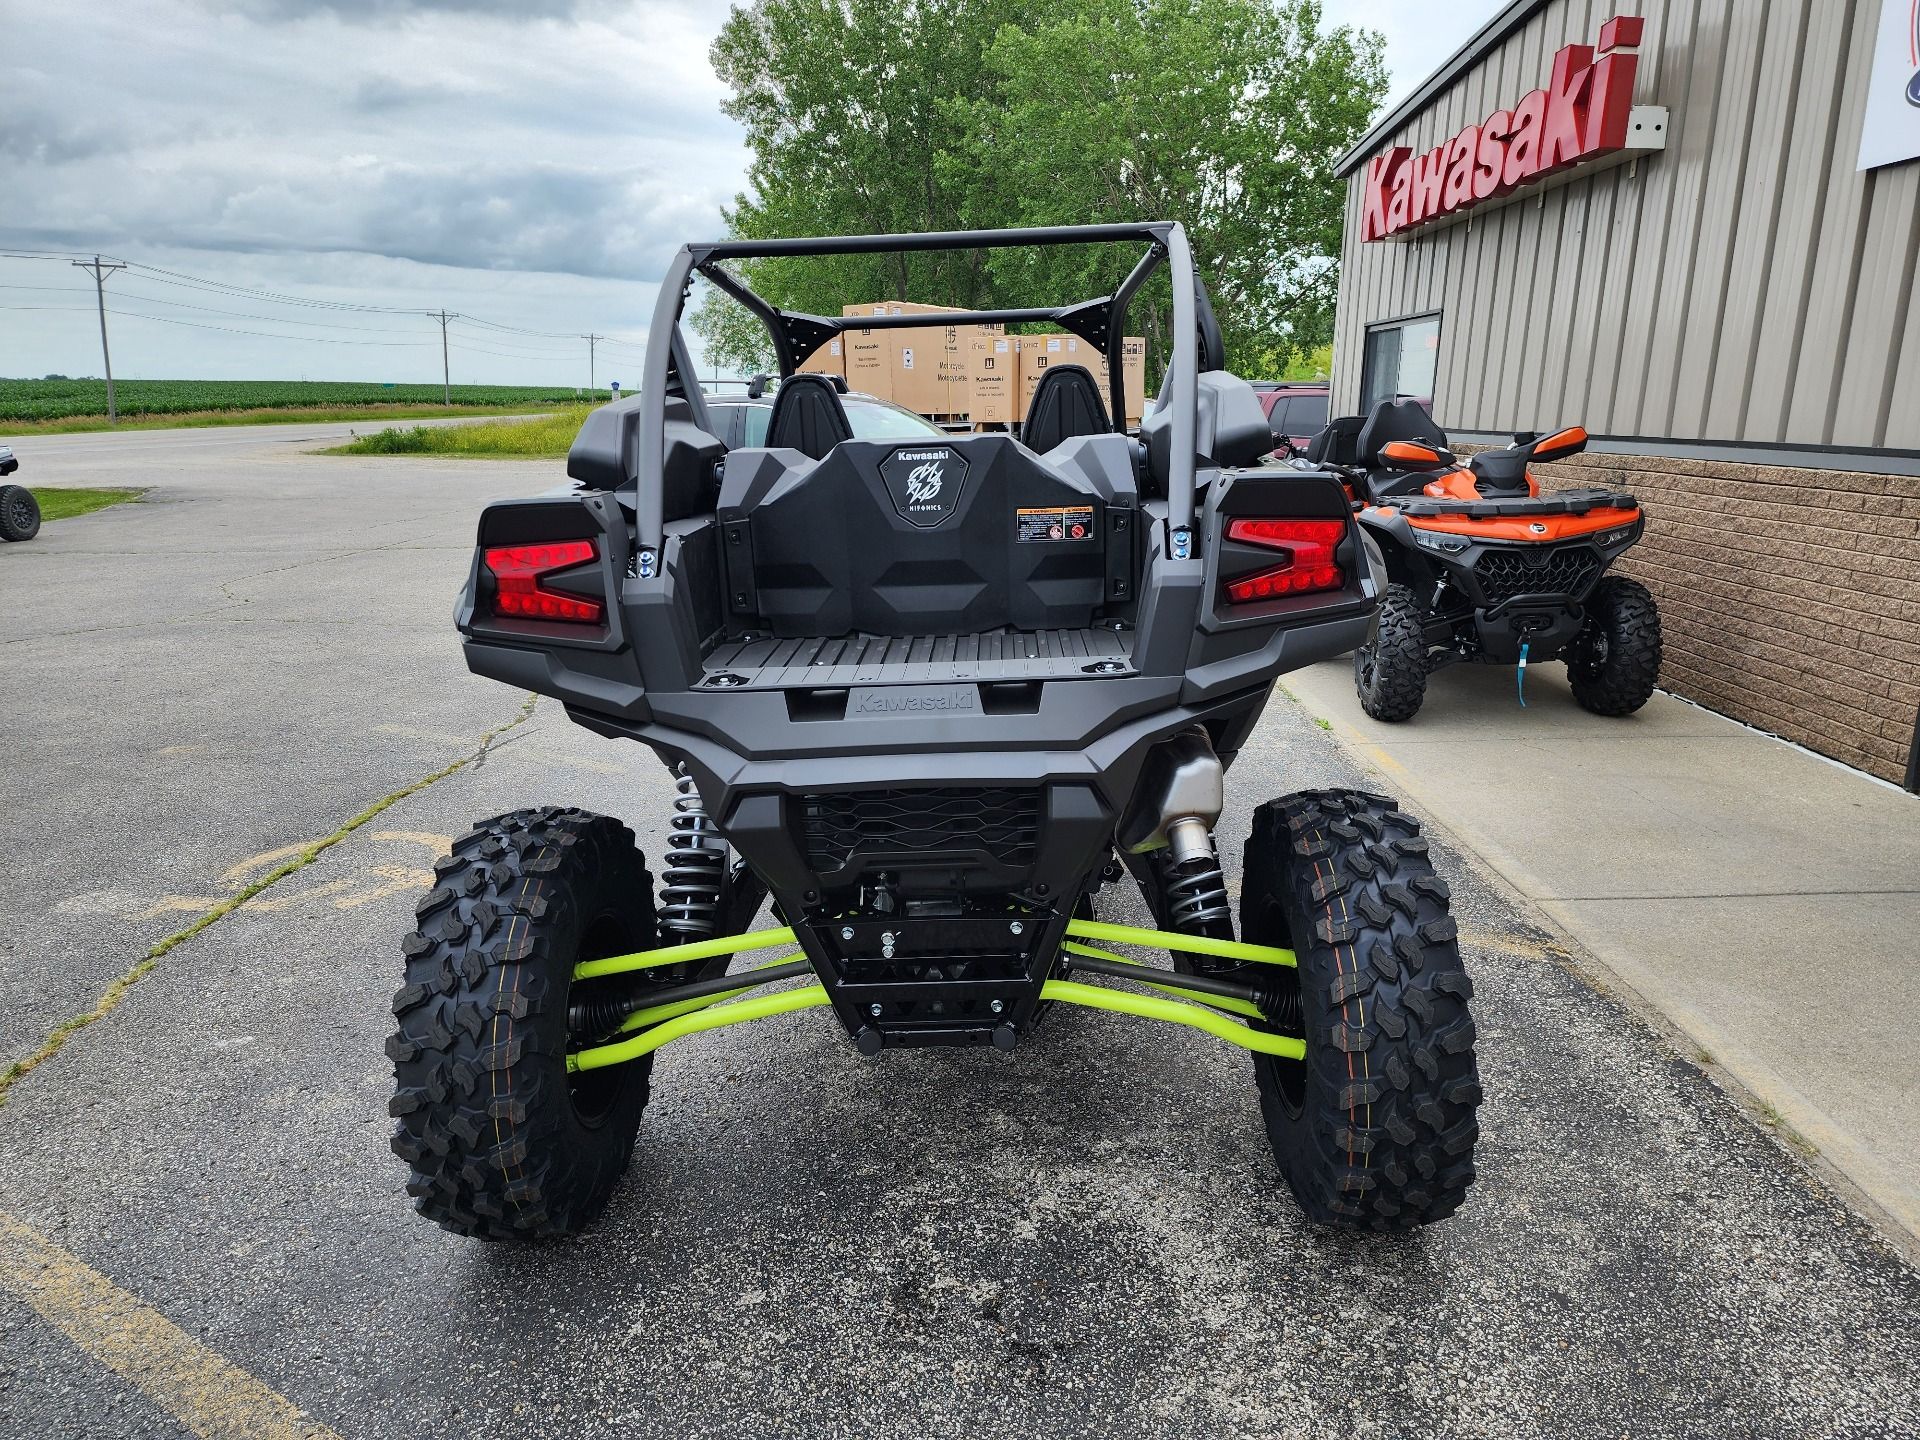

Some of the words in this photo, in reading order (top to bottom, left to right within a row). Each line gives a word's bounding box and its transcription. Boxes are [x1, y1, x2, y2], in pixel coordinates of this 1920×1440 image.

[1360, 16, 1645, 243] Kawasaki
[898, 450, 949, 461] Kawasaki
[909, 504, 942, 512] HIFONICS
[855, 690, 973, 713] Kawasaki
